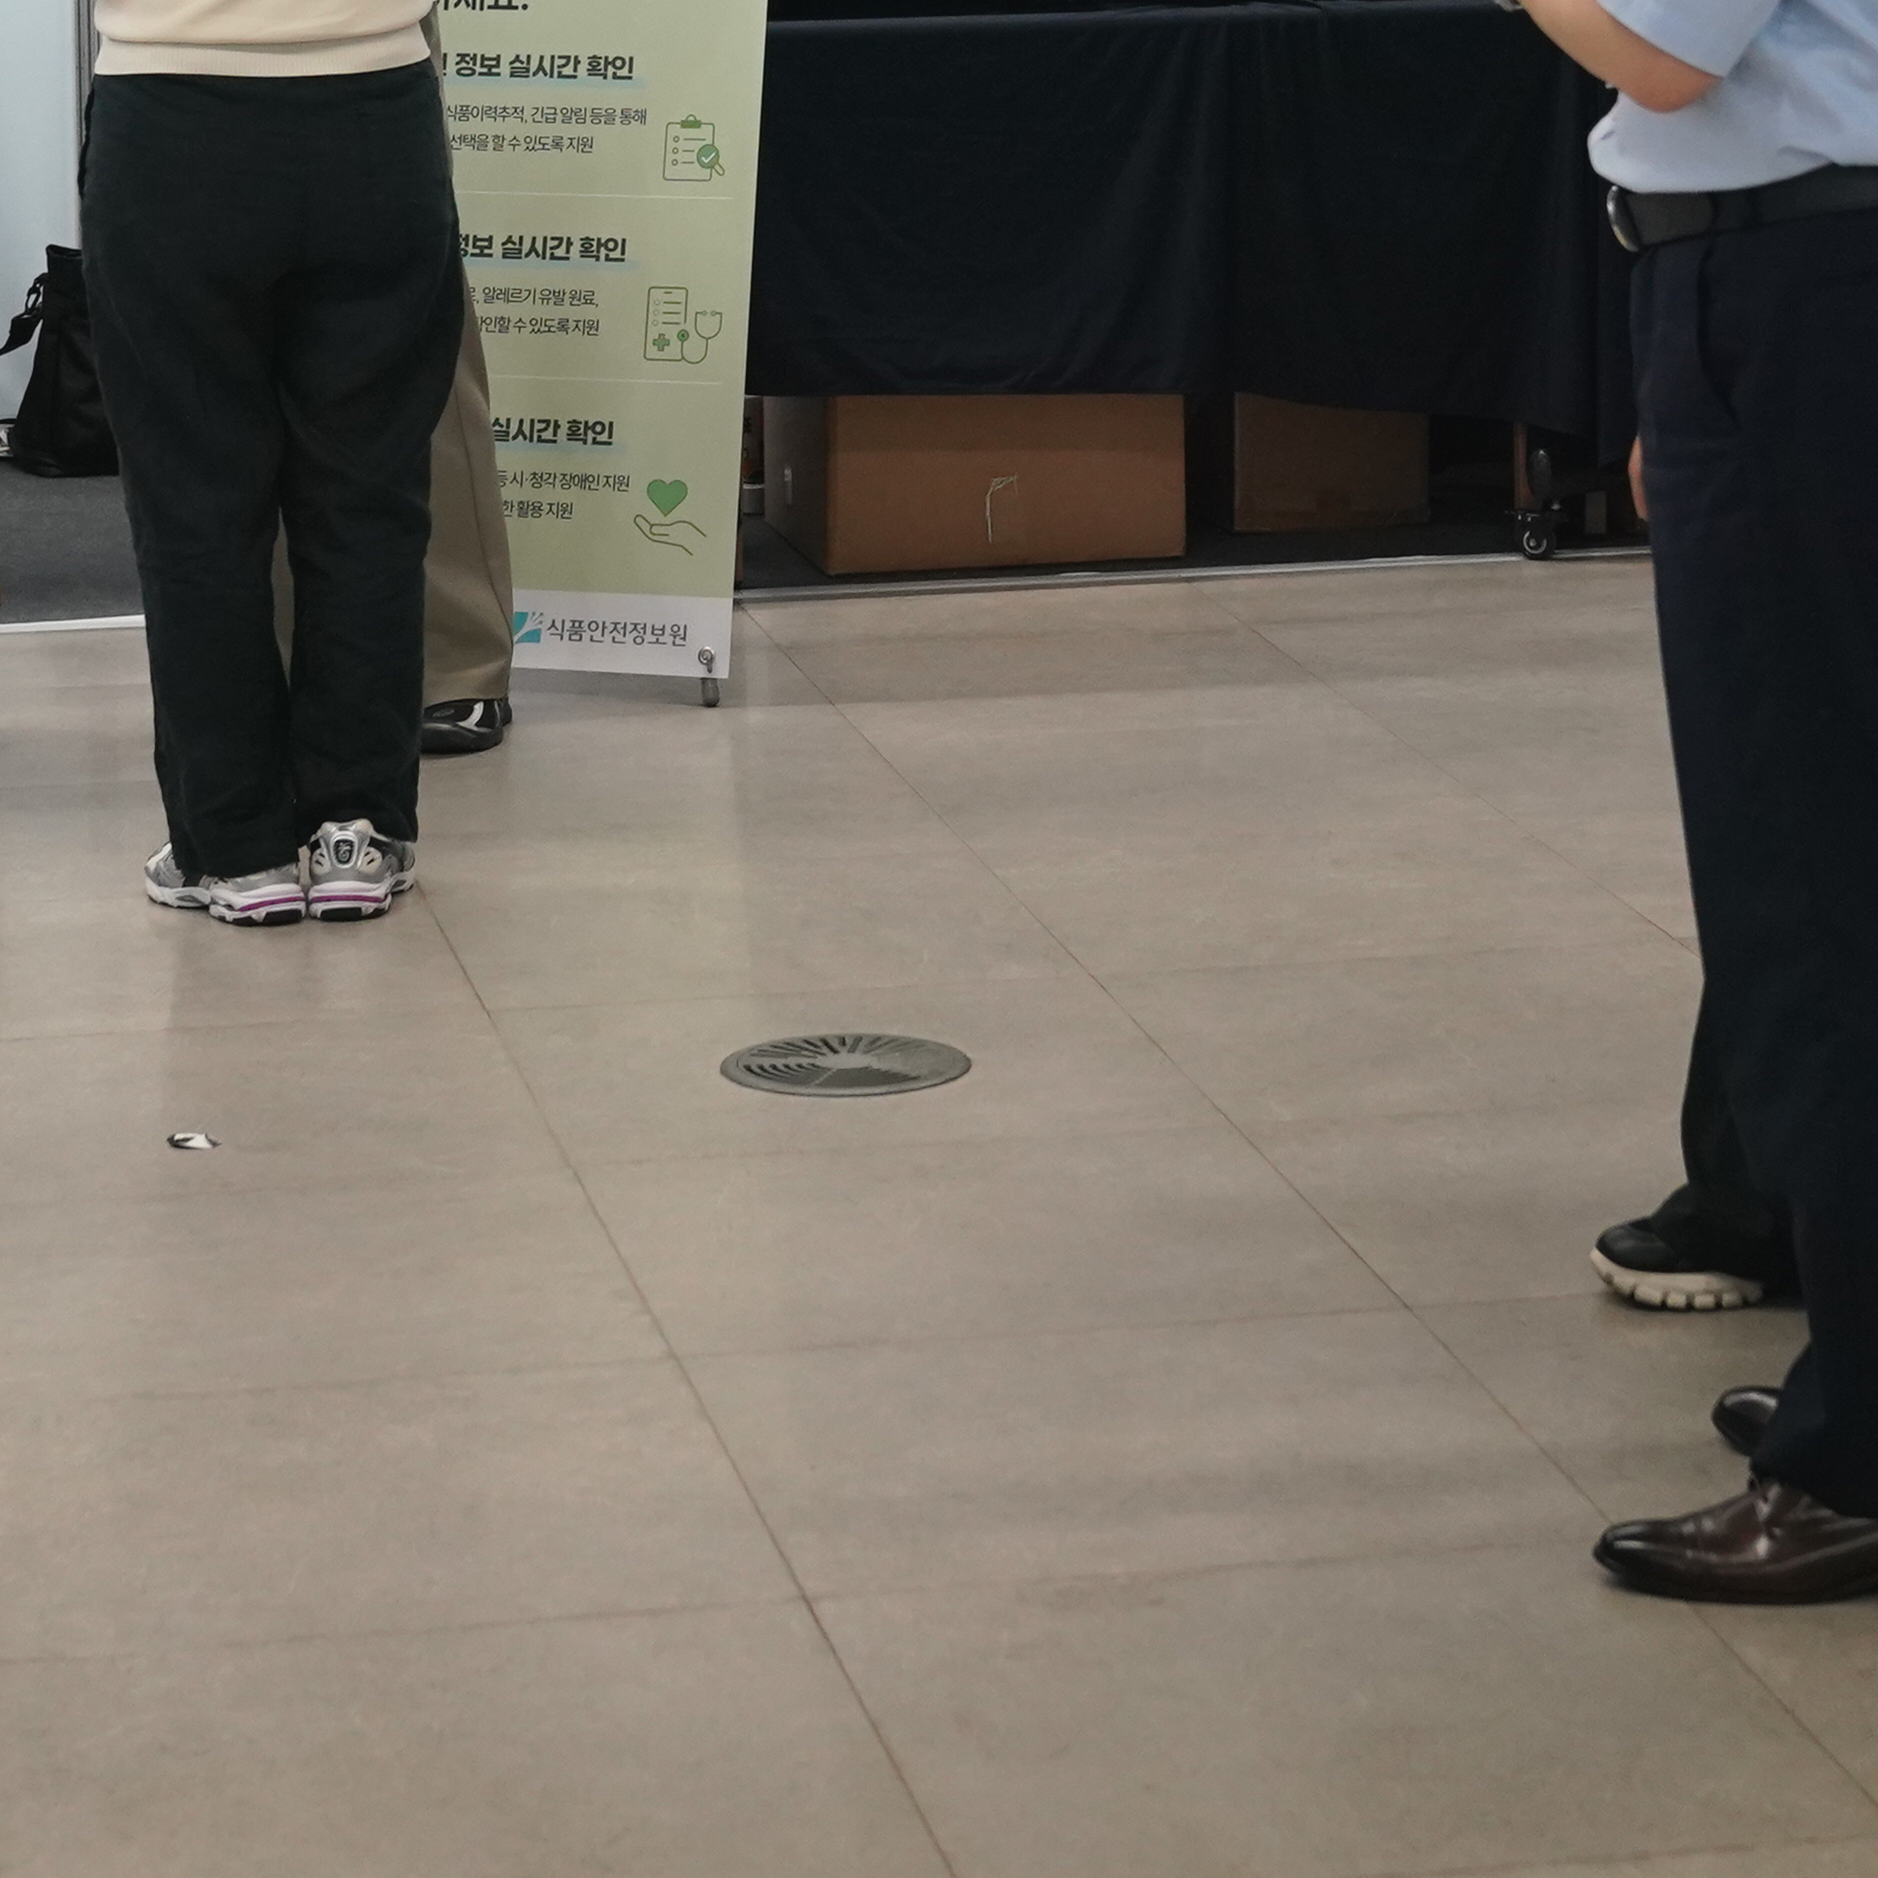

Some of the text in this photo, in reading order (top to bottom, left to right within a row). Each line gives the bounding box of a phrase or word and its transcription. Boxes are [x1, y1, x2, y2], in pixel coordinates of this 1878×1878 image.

[455, 53, 633, 80] 정보 실시간 확인
[531, 107, 557, 123] 긴급
[560, 107, 587, 124] 알림
[590, 108, 617, 125] 등을
[620, 108, 646, 125] 통해
[501, 235, 626, 262] 실시간 확인
[492, 418, 613, 445] 실시간 확인
[602, 475, 629, 492] 지원
[547, 619, 687, 646] 식품안전정보원
